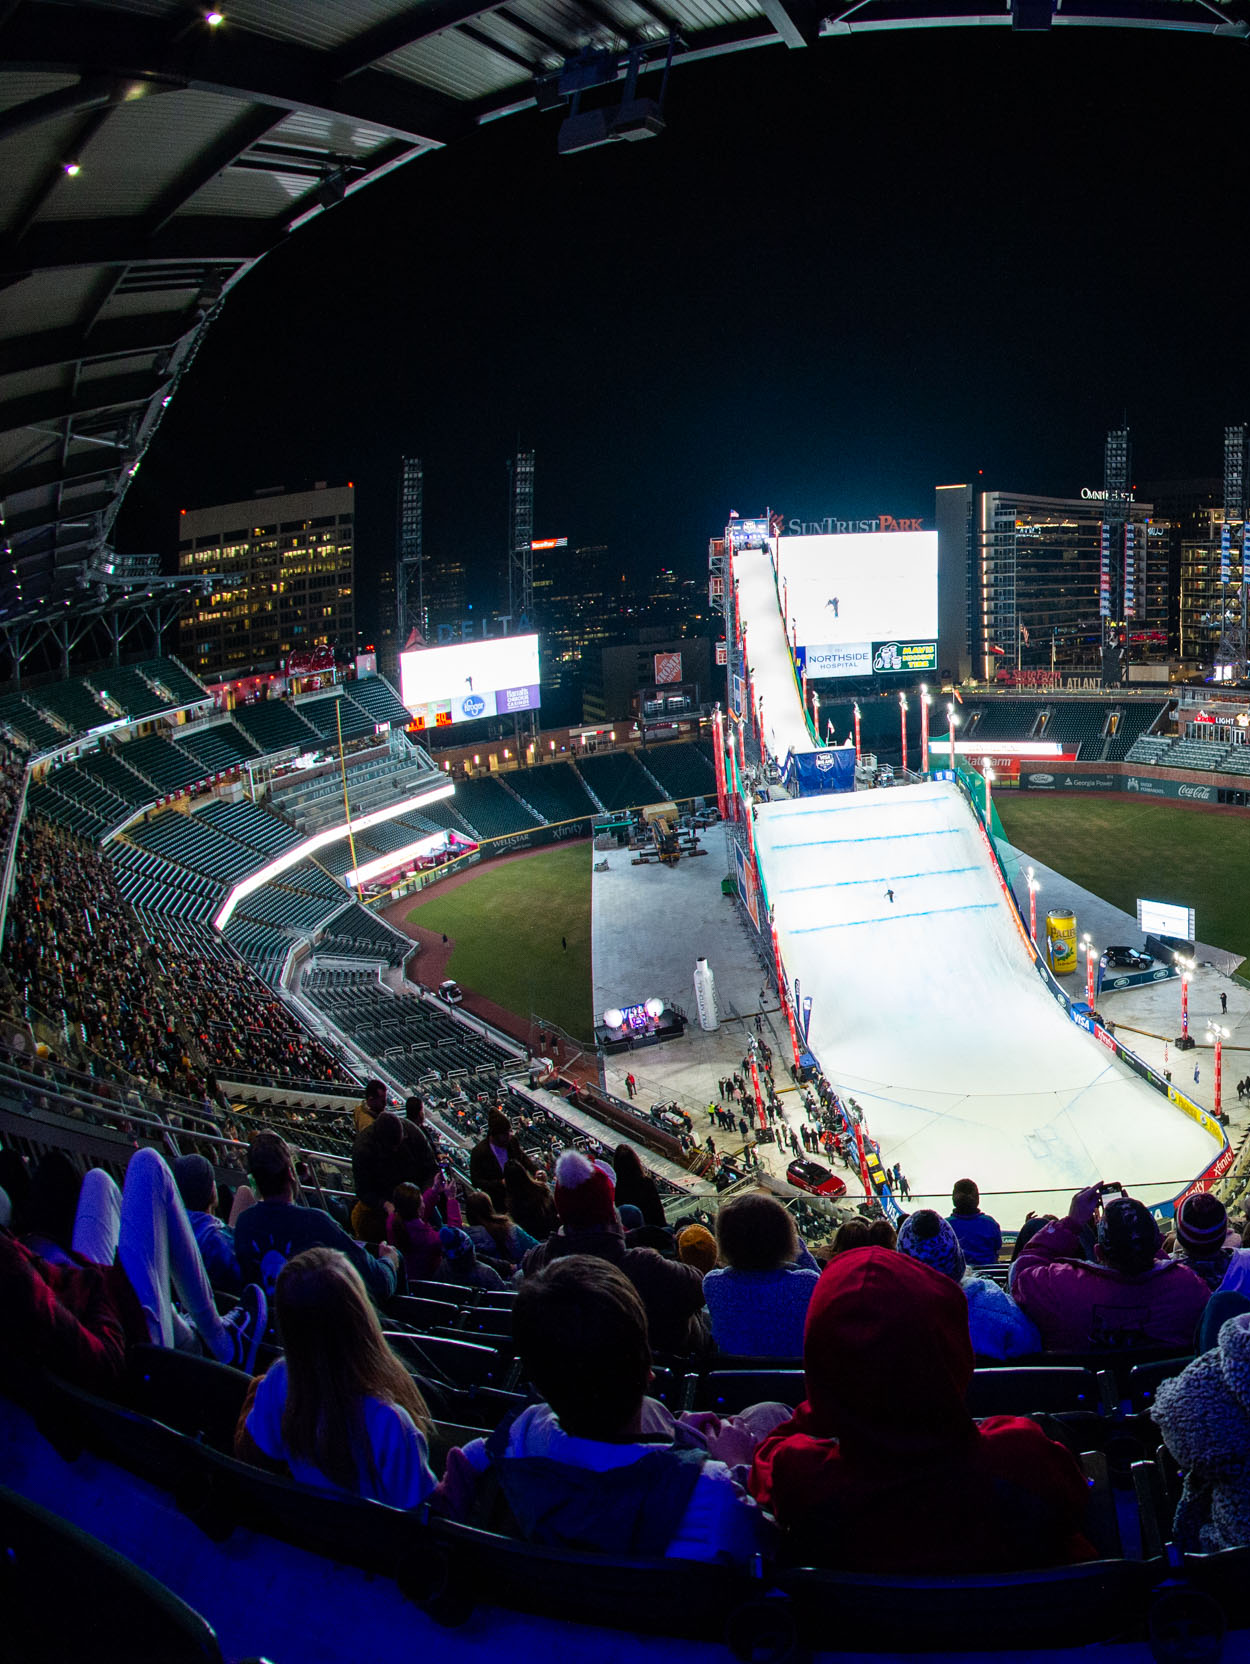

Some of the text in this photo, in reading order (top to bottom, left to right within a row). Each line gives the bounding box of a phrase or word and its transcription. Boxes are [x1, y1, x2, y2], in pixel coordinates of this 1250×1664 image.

[437, 613, 531, 644] DELTA
[809, 653, 869, 663] NORTHSIDE
[902, 646, 934, 654] MAVIS
[657, 655, 681, 683] HOME
[1067, 677, 1102, 690] ATLANT
[464, 699, 485, 716] Kroger
[1215, 717, 1235, 725] LIGHT
[1073, 779, 1095, 787] Georgia
[552, 823, 584, 840] xfinity
[492, 833, 529, 848] WELLSTAR
[1073, 1011, 1090, 1030] VISA
[1213, 1150, 1233, 1177] xfinity
